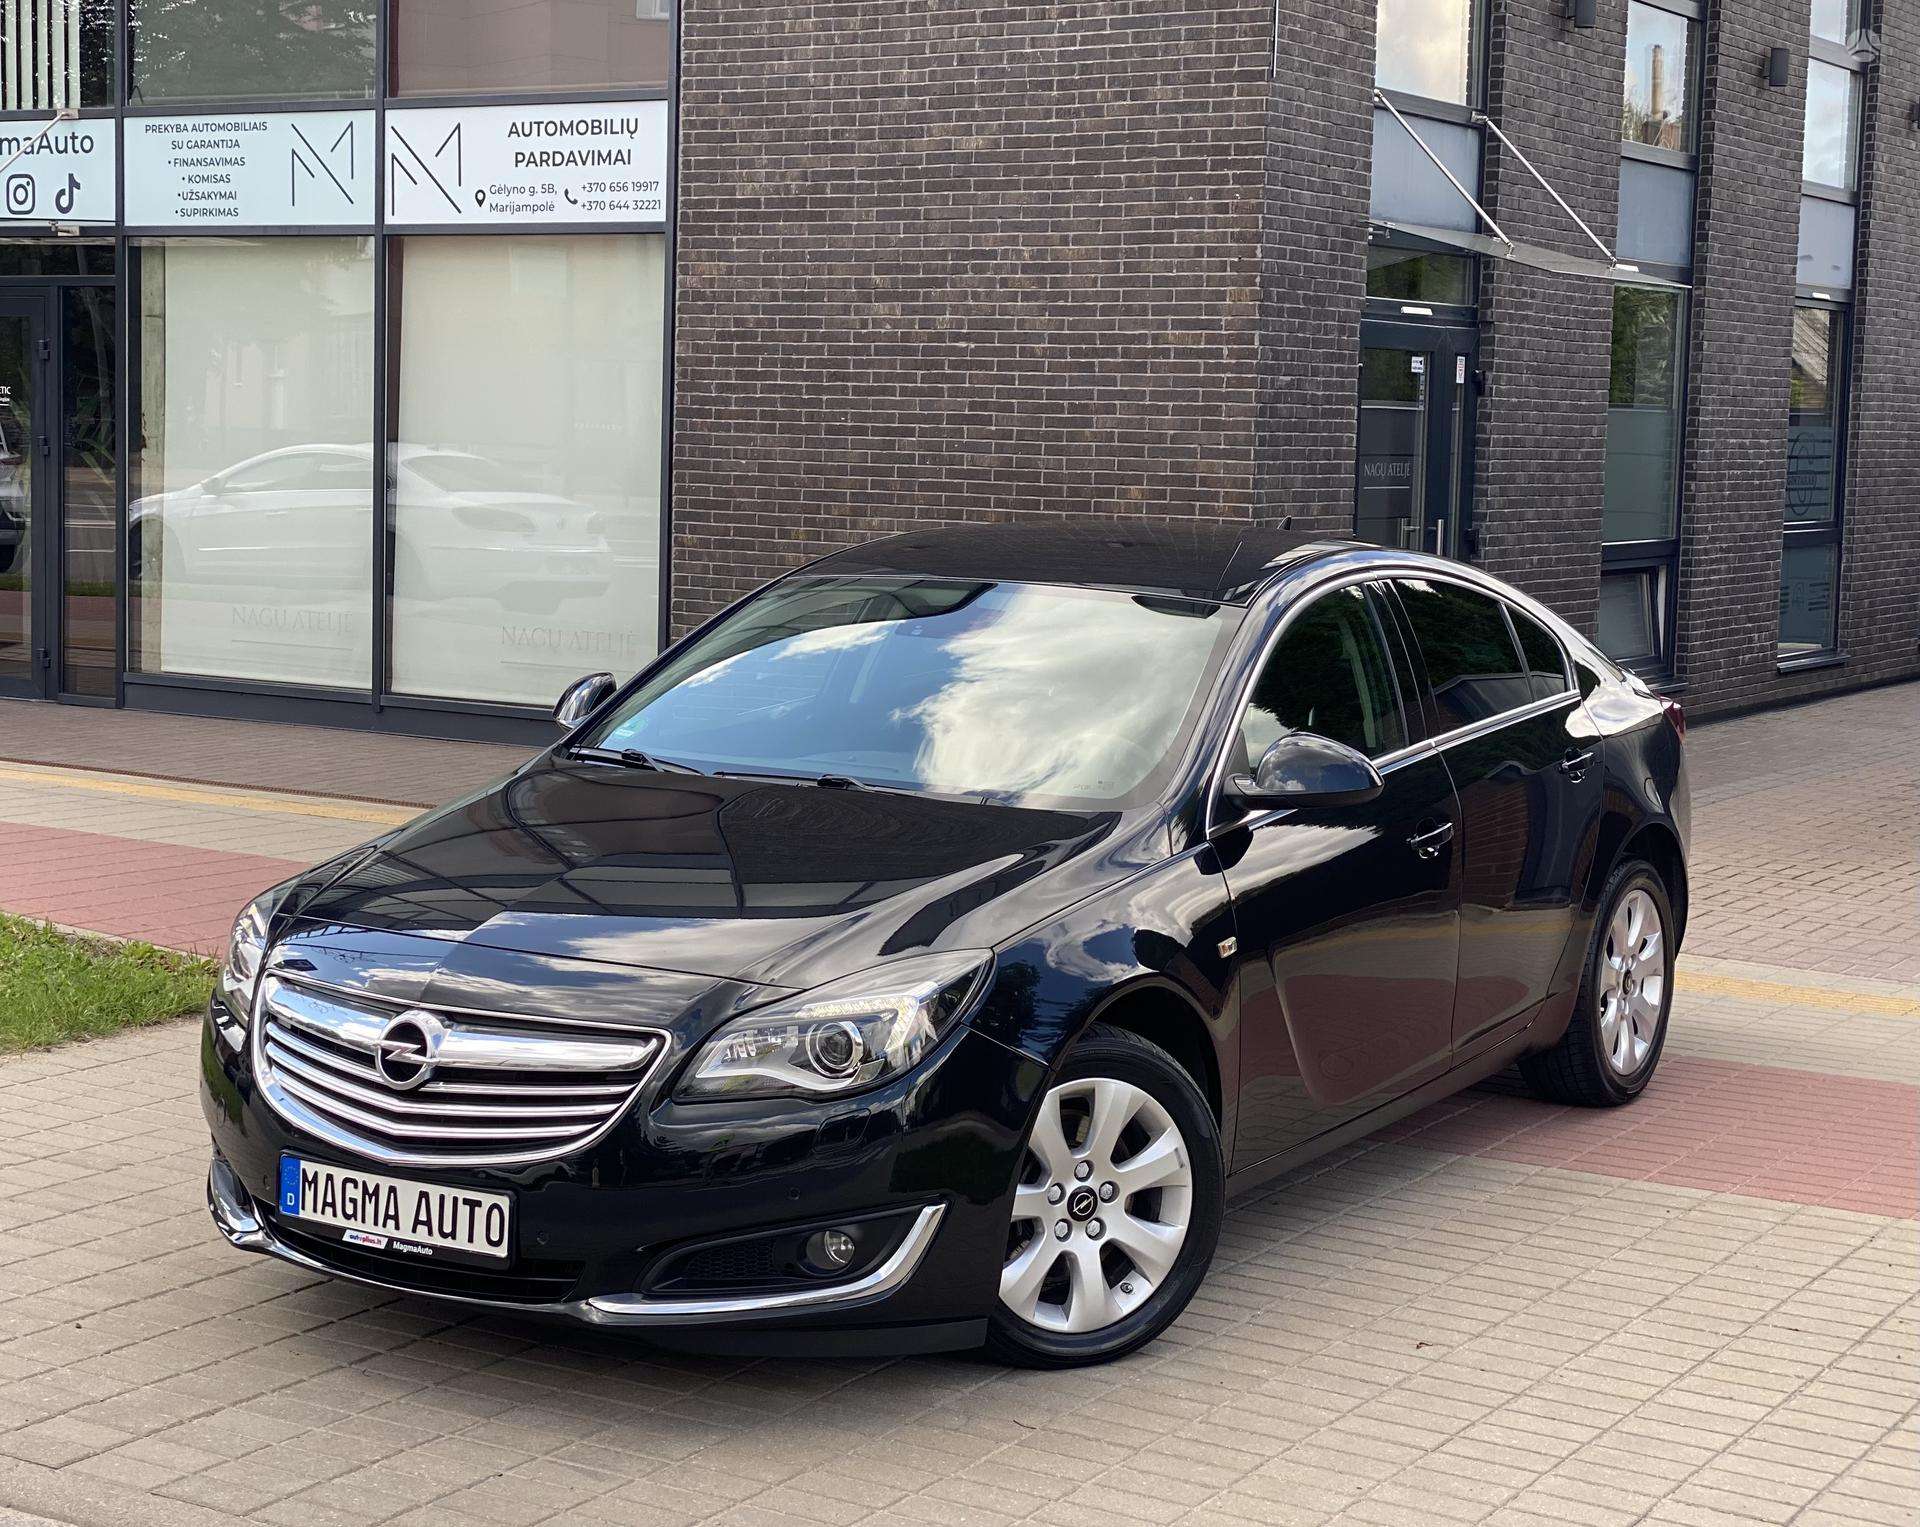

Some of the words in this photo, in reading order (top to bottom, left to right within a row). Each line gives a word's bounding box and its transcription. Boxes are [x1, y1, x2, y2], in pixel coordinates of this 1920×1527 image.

[145, 123, 189, 133] PREKYBA
[191, 121, 268, 133] AUTOMOBILIAIS
[508, 118, 638, 139] AUTOMOBILIŲ
[171, 140, 184, 150] SU
[186, 139, 241, 150] GARANTIJA
[174, 157, 246, 167] FINANSAVIMAS
[515, 149, 631, 168] PARDAVIMAI
[188, 174, 231, 184] KOMISAS
[489, 184, 526, 196] Gėlyno
[529, 186, 538, 196] g.
[541, 184, 557, 195] 5B,
[581, 182, 606, 193] +370
[609, 182, 629, 192] 656
[632, 181, 659, 192] 19917
[182, 189, 237, 201] UŽSAKYMAI
[489, 201, 555, 214] Marijampolė
[581, 200, 606, 211] +370
[609, 200, 630, 211] 644
[632, 199, 661, 210] 32221
[180, 208, 239, 217] SUPIRKIMAS
[0, 386, 11, 395] TIC
[287, 1192, 295, 1206] D
[301, 1167, 400, 1231] MAGMA
[411, 1189, 505, 1248] AUTO
[393, 1241, 433, 1255] MagmaAuto
